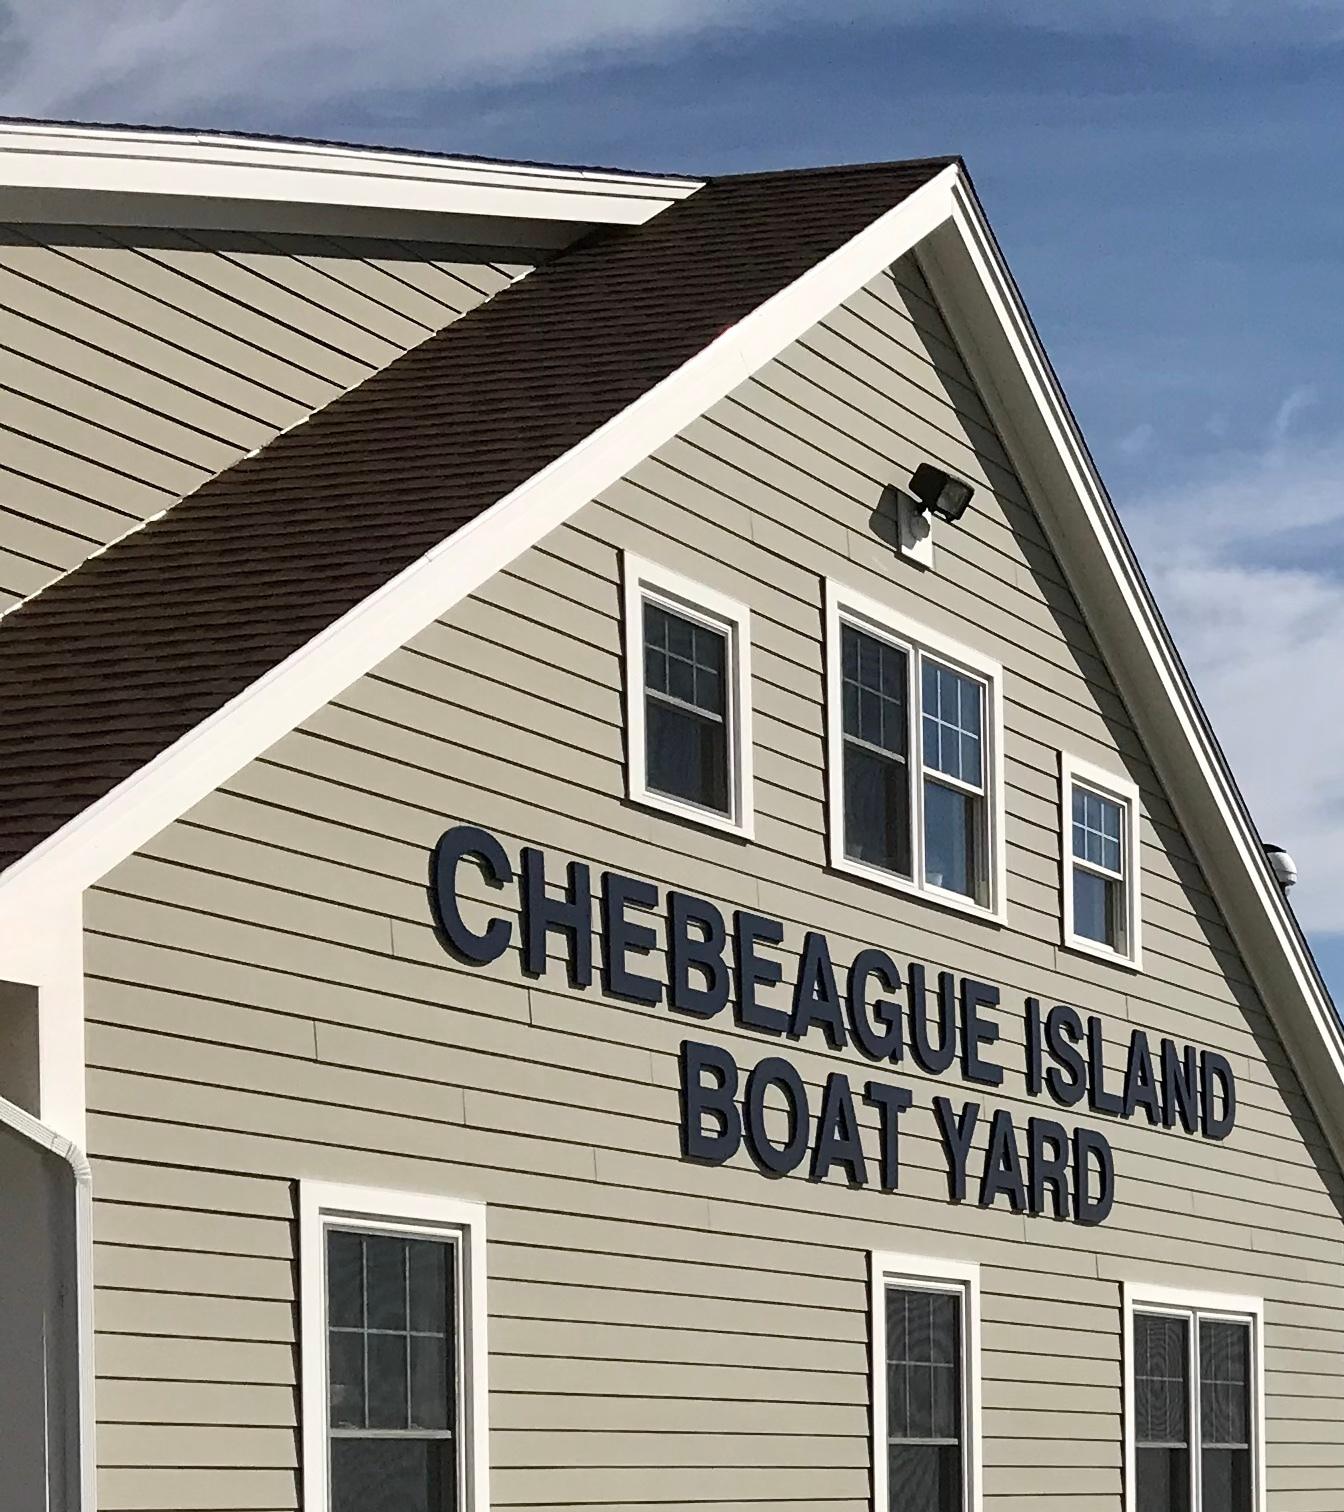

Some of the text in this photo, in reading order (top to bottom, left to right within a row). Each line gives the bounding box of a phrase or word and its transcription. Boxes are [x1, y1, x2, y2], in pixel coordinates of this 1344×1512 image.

[429, 825, 1237, 1141] CHEBEAGUE ISLAND
[680, 1039, 1116, 1227] BOAT YARD
